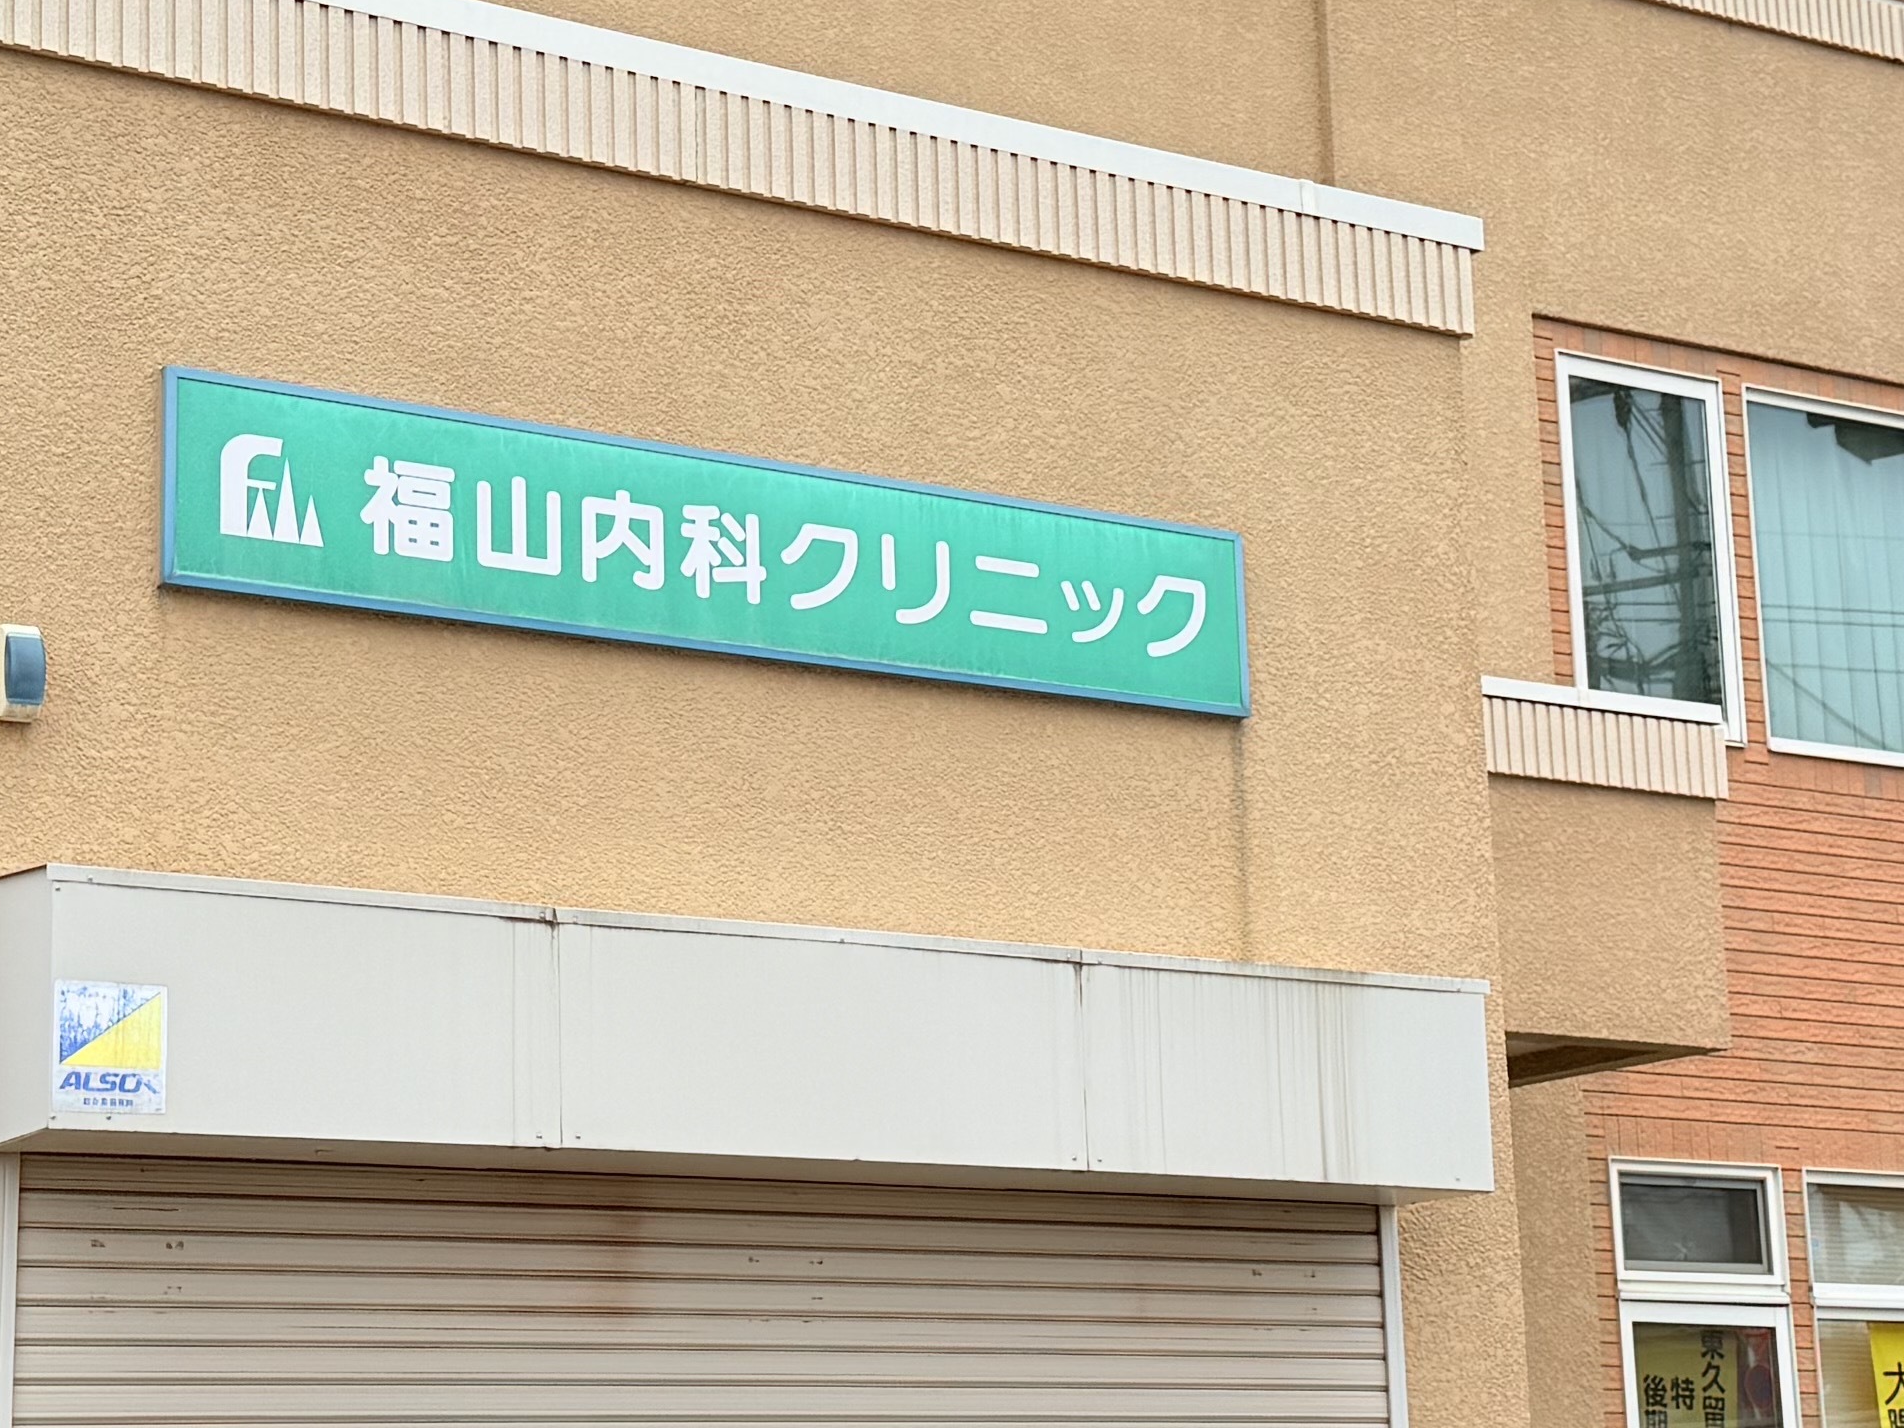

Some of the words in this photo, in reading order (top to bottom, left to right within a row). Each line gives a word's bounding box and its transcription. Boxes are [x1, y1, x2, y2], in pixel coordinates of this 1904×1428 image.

[359, 455, 1207, 658] 福山内科クリニック
